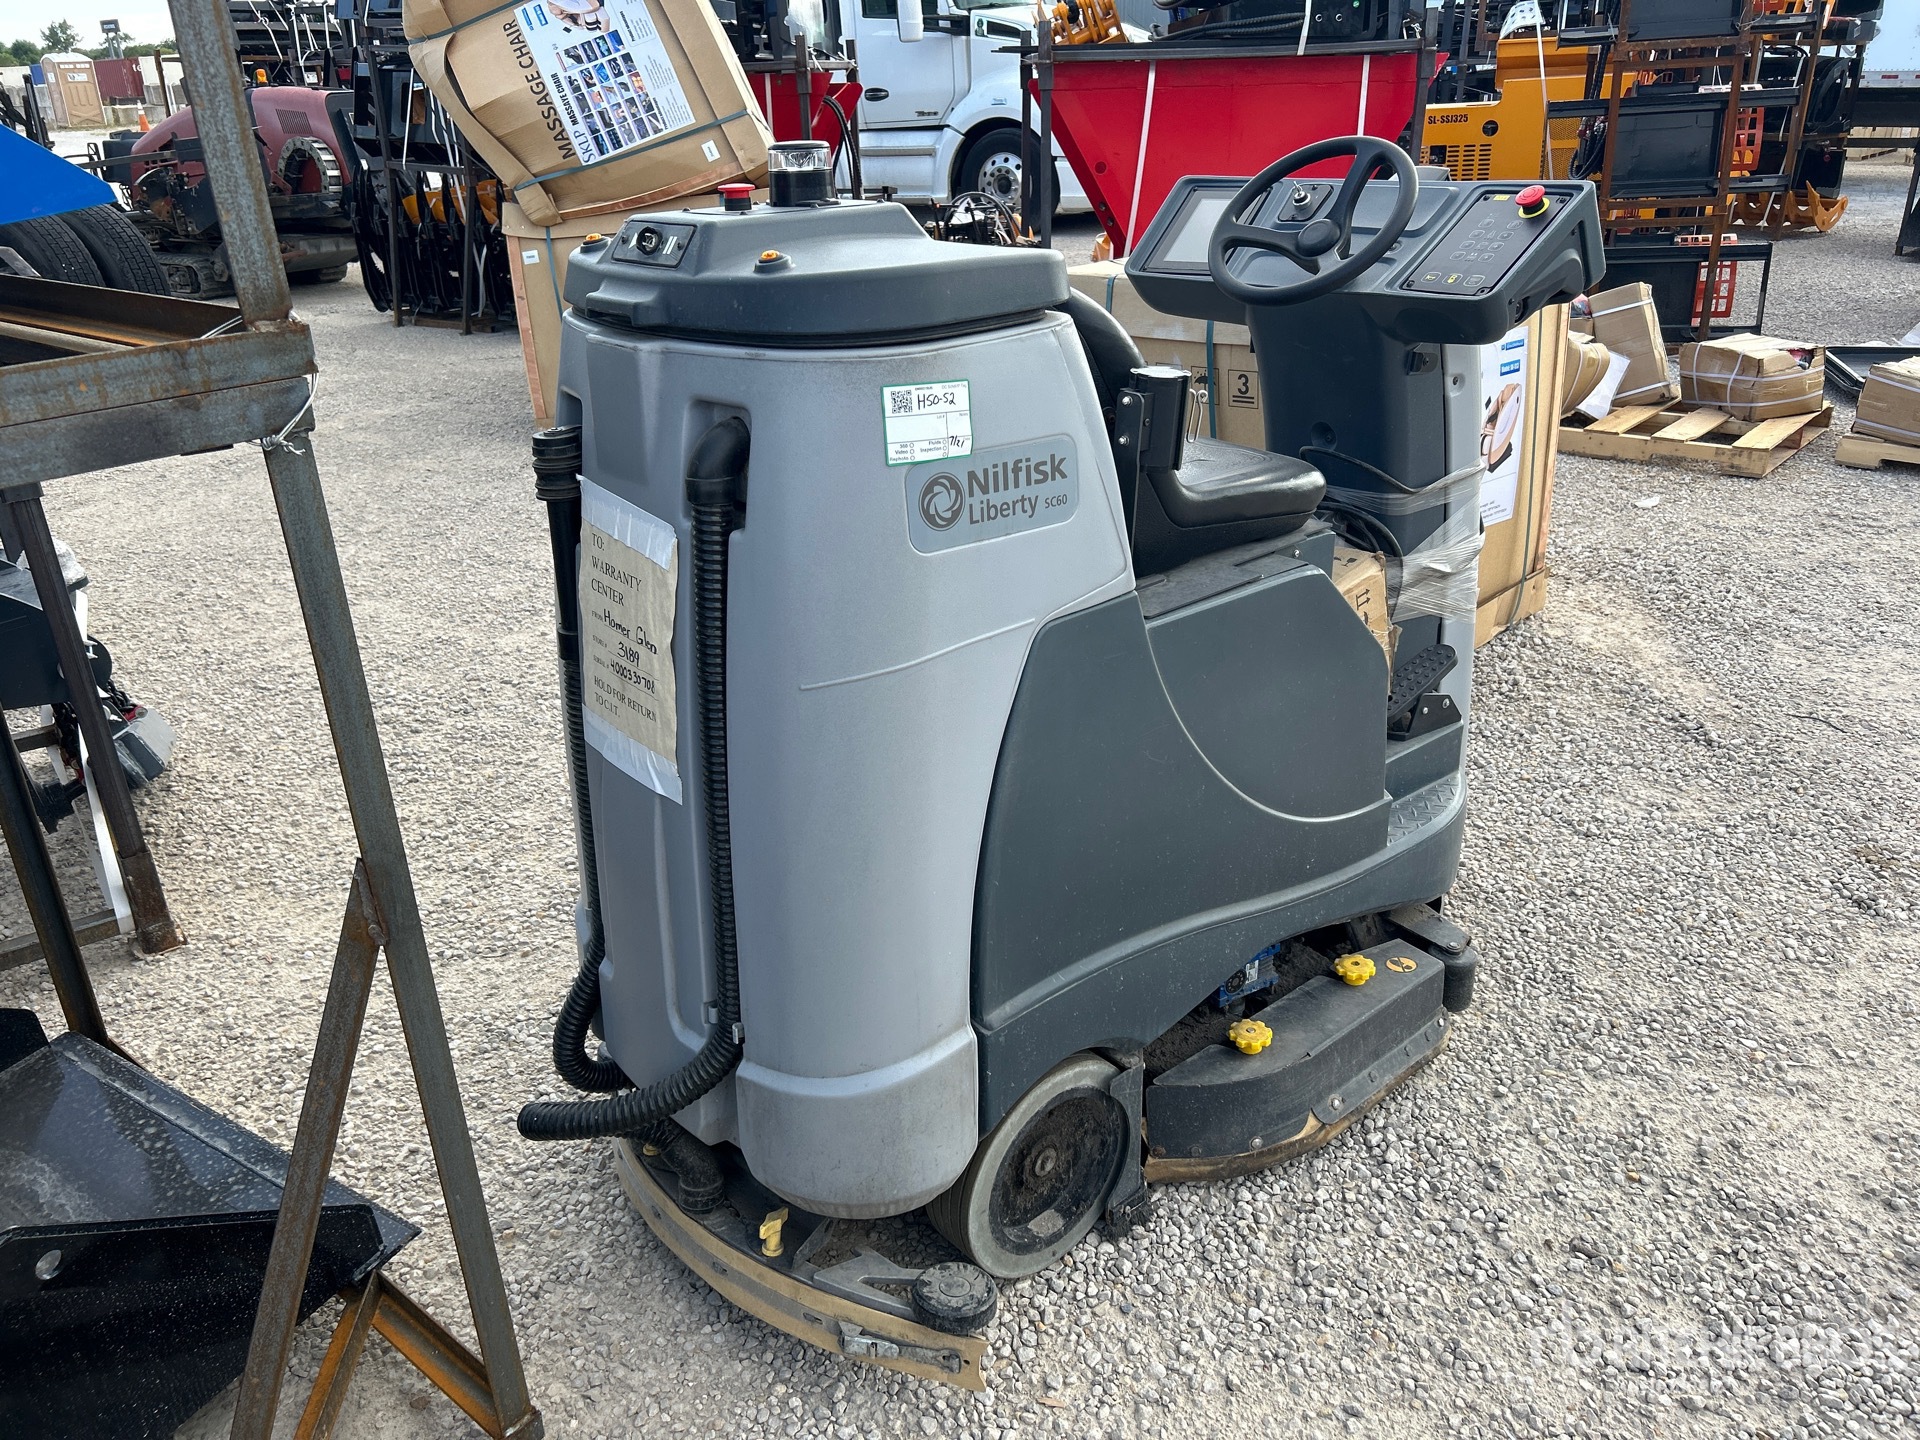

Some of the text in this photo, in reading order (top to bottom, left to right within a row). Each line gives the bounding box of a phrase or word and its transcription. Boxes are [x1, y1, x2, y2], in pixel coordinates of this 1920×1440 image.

[502, 18, 577, 160] MASSAGE CHAIR
[550, 72, 565, 94] CHAIR
[1427, 113, 1469, 125] SL-SSJ325
[573, 130, 597, 164] SKLP
[1236, 373, 1250, 395] 3
[966, 453, 1068, 498] Nilfisk
[968, 493, 1068, 525] Liberty SC60
[591, 532, 605, 551] TO:
[591, 555, 642, 592] WARRANTY
[591, 578, 625, 607] CENTER
[603, 608, 631, 639] Homer
[635, 626, 657, 655] Glen
[617, 641, 640, 667] 3189
[594, 675, 657, 723] HOLD FOR RETURN
[595, 691, 604, 705] TO
